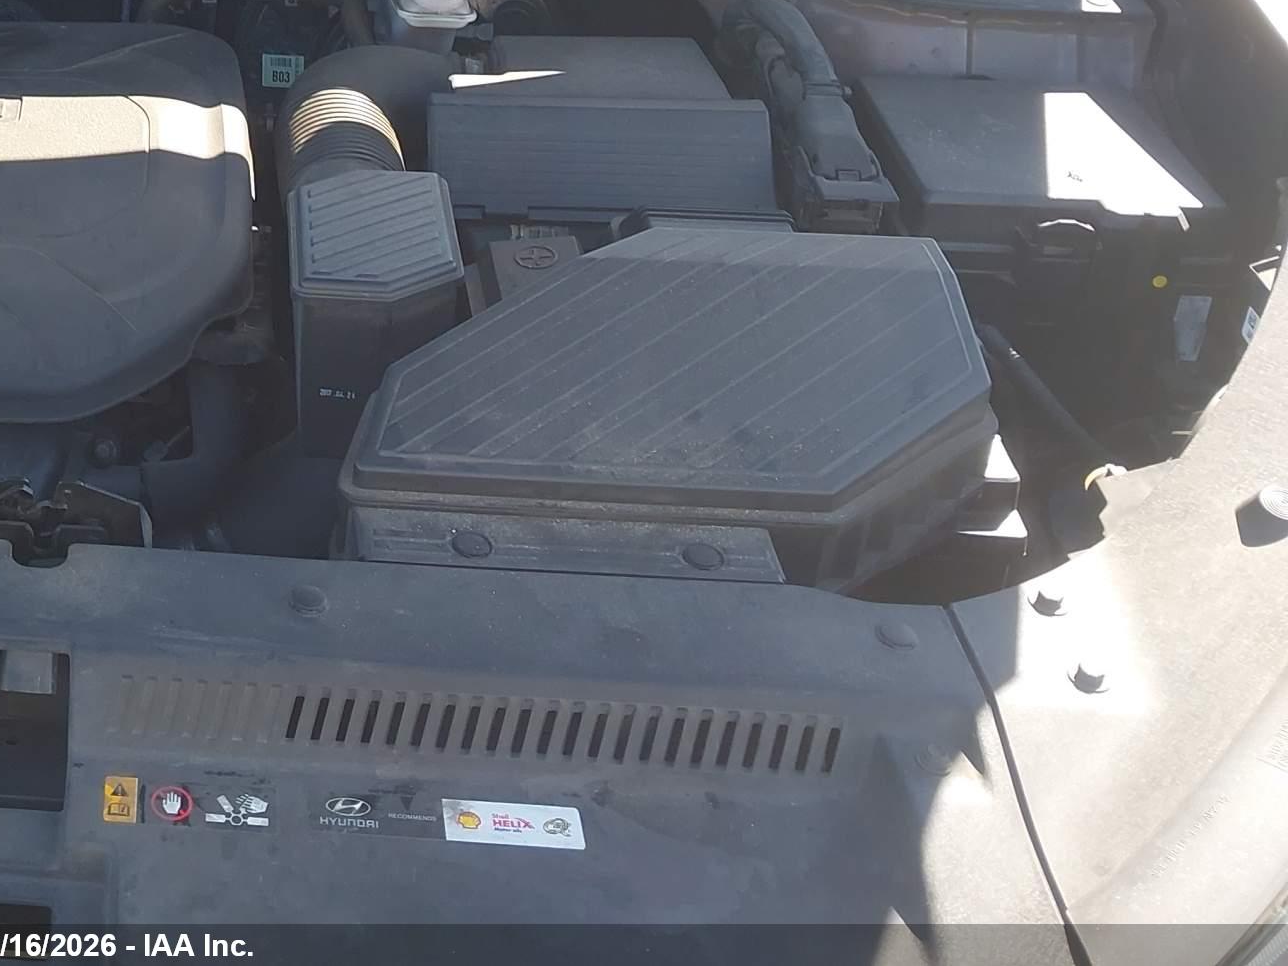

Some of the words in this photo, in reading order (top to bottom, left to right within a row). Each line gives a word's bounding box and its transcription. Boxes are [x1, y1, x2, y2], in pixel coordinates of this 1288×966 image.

[272, 70, 290, 83] B03
[319, 816, 379, 829] HYUNDAI
[388, 813, 437, 822] RECOMMENDS
[492, 818, 533, 830] HELIX
